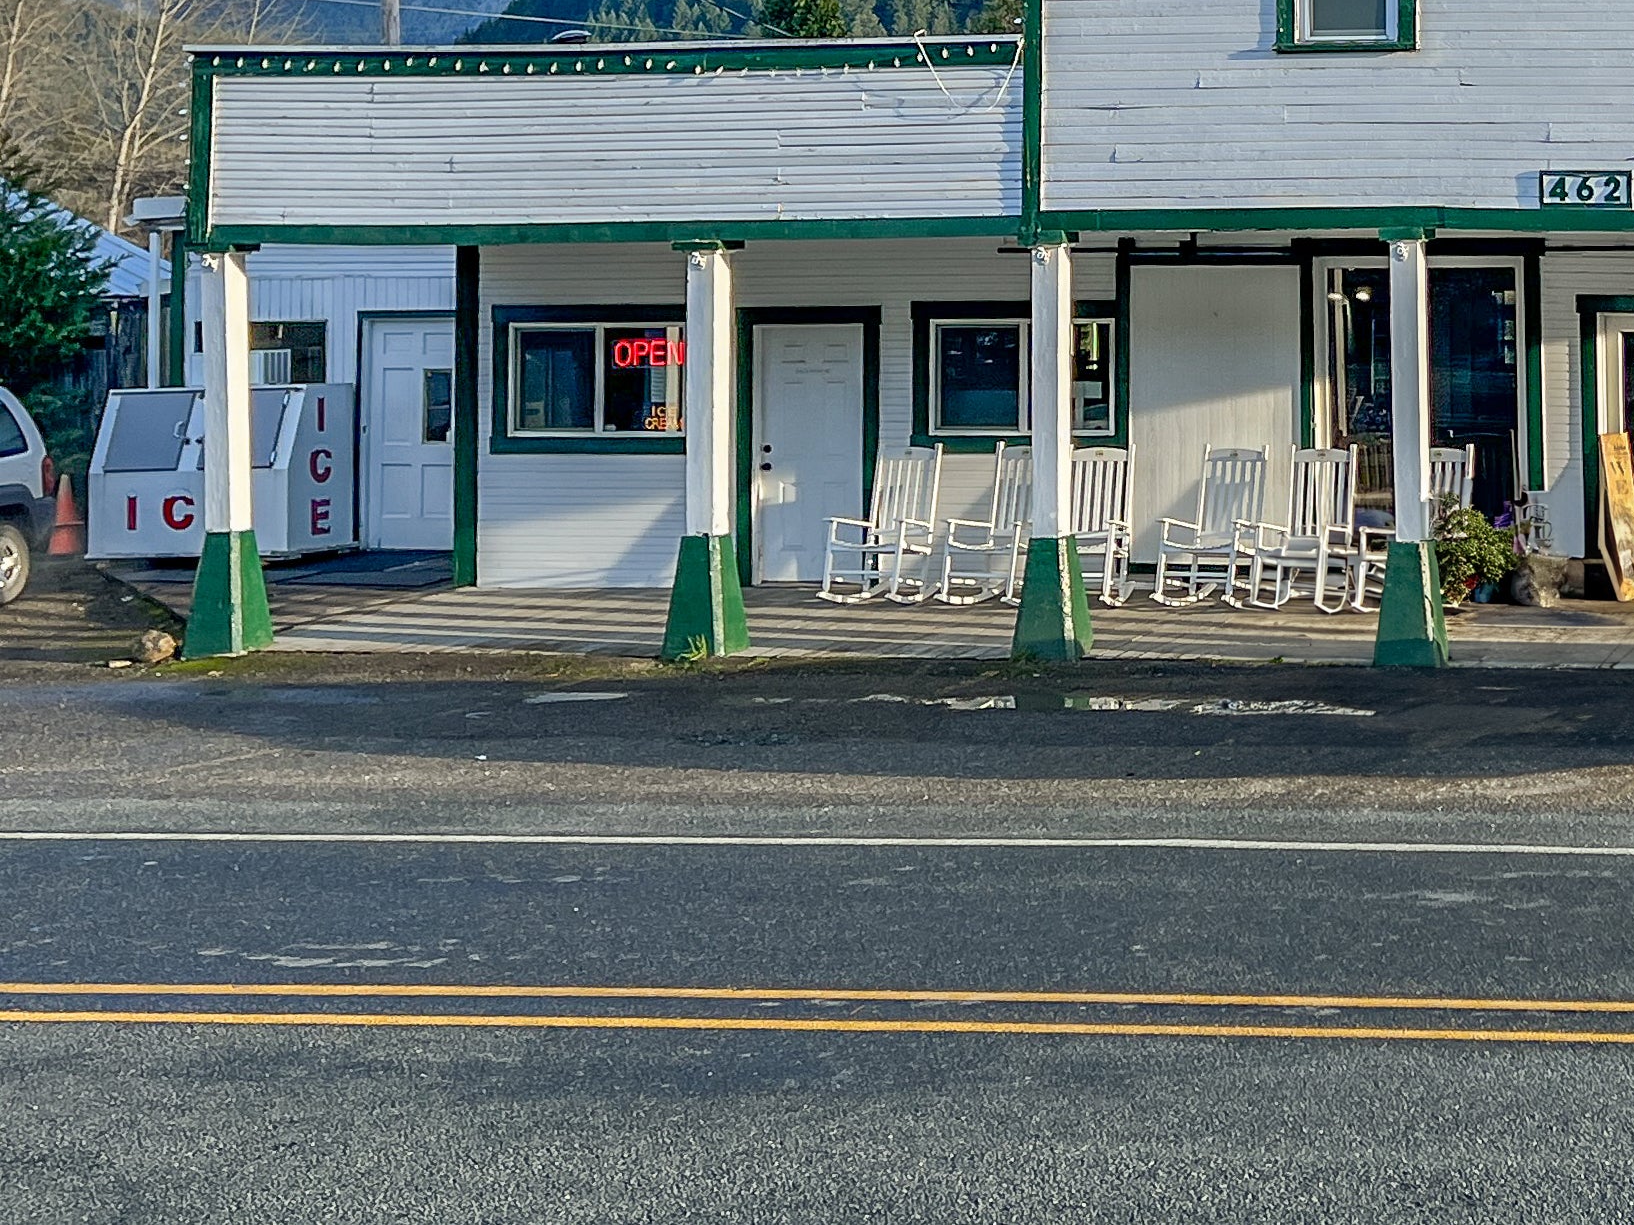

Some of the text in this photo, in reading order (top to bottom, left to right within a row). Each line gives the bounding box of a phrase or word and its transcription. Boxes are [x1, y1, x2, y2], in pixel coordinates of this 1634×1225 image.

[1549, 176, 1621, 202] 462
[614, 338, 685, 366] OPEN
[651, 405, 678, 417] ICE
[309, 396, 333, 536] ICE
[126, 494, 196, 531] IC
